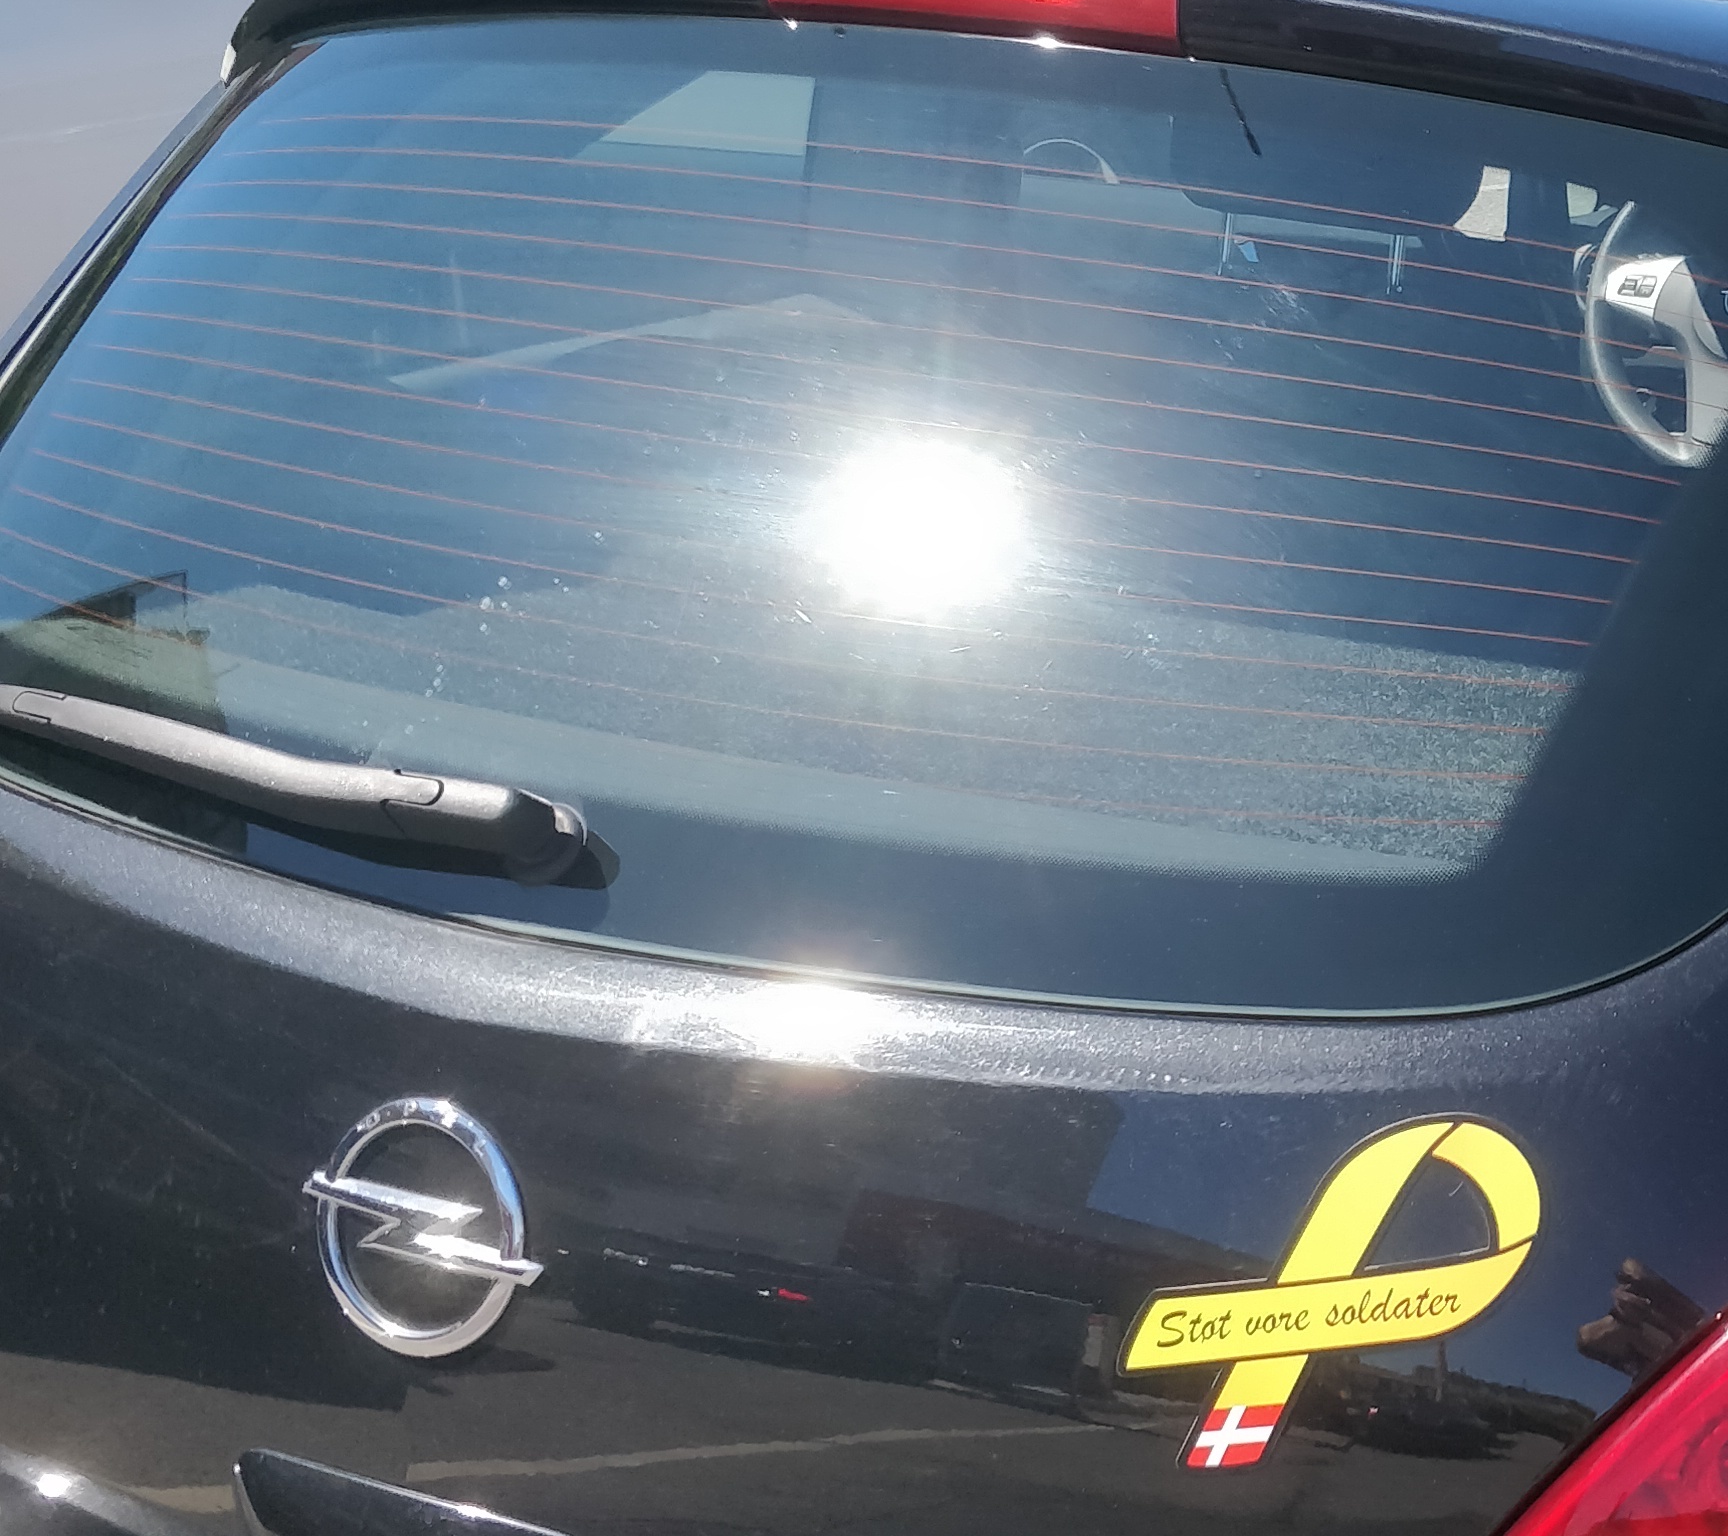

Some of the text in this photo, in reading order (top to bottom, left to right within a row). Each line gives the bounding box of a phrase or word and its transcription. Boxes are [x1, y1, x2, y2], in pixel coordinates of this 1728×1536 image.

[1156, 1287, 1462, 1348] Støt vore soldater
